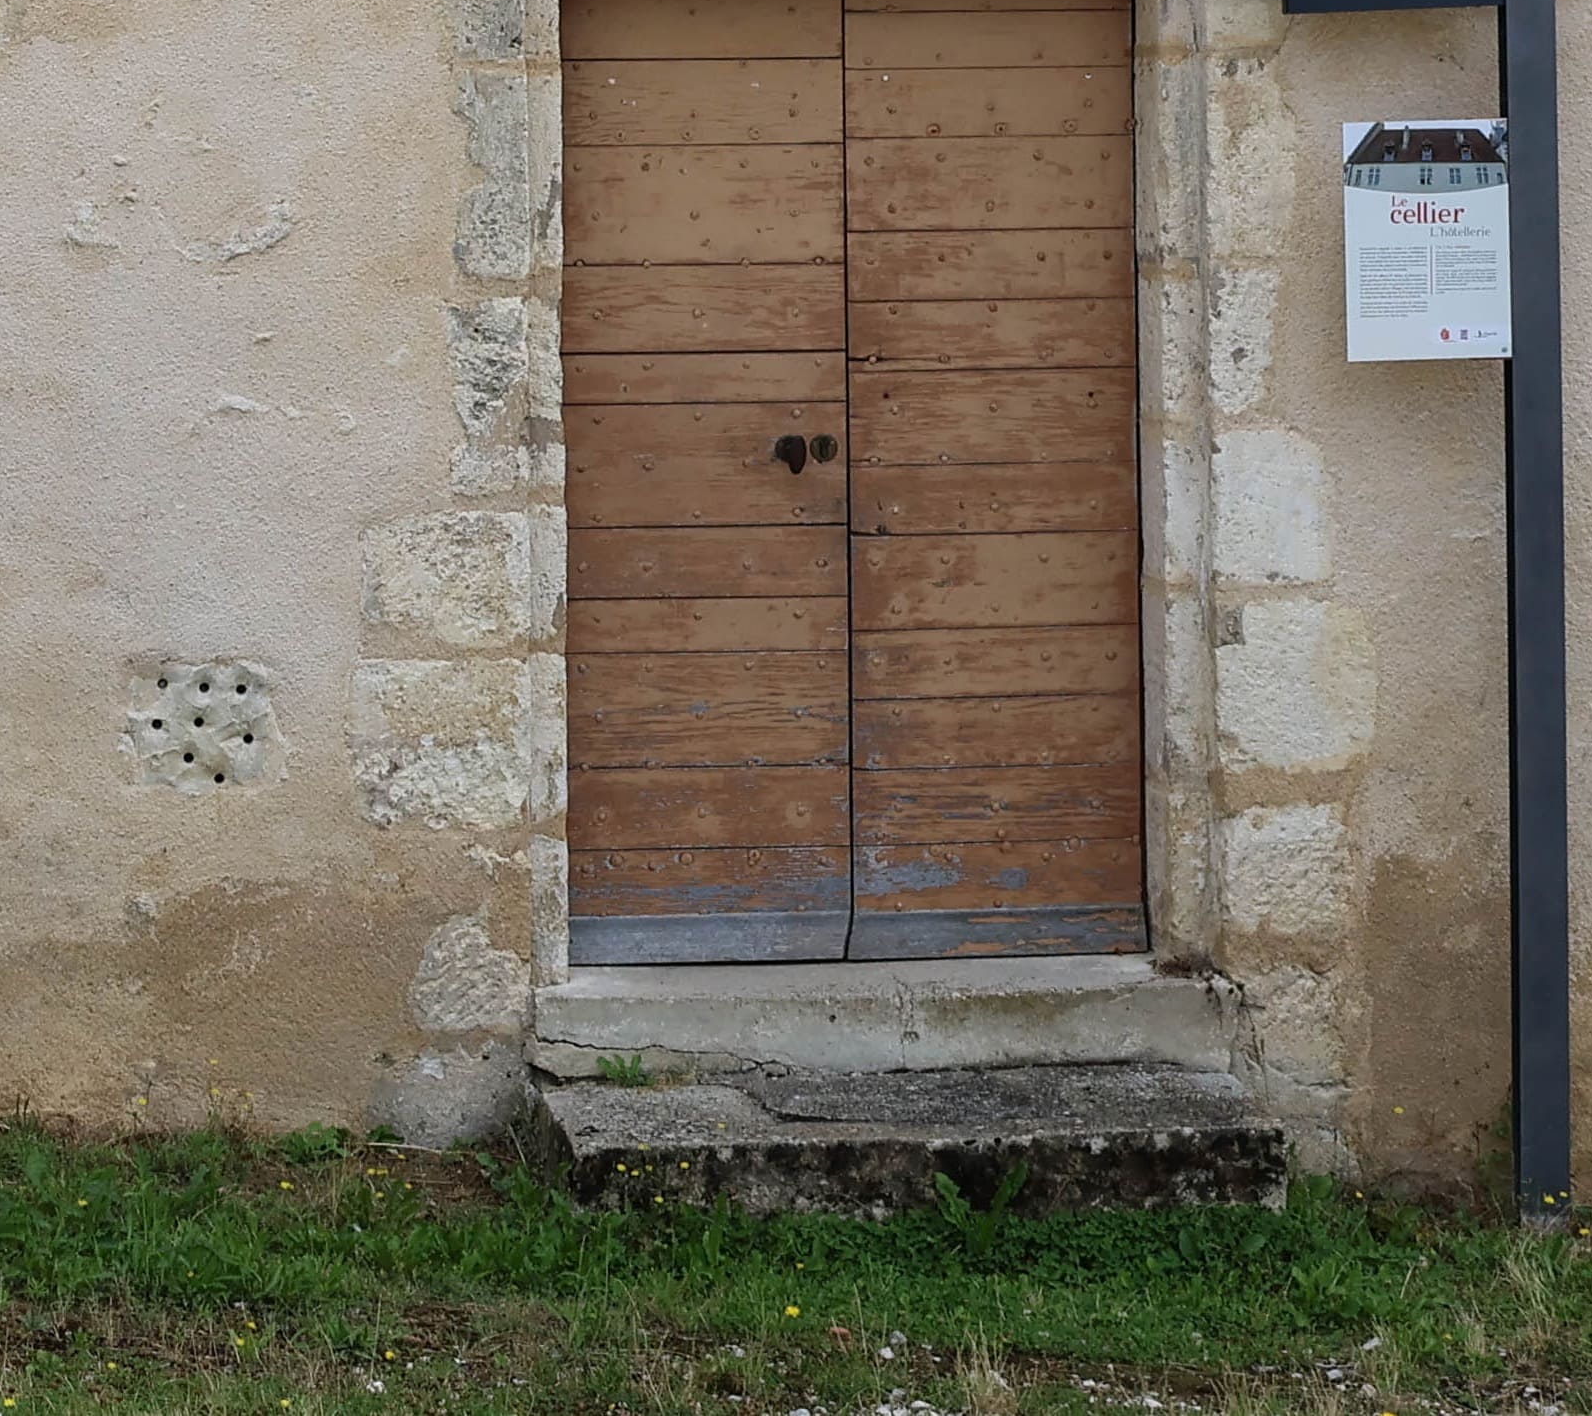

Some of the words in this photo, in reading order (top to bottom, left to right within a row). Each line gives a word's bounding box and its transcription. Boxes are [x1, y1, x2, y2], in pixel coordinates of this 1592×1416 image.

[1391, 195, 1408, 207] Le
[1390, 201, 1465, 224] cellier
[1430, 225, 1492, 238] L'hôtellerie
